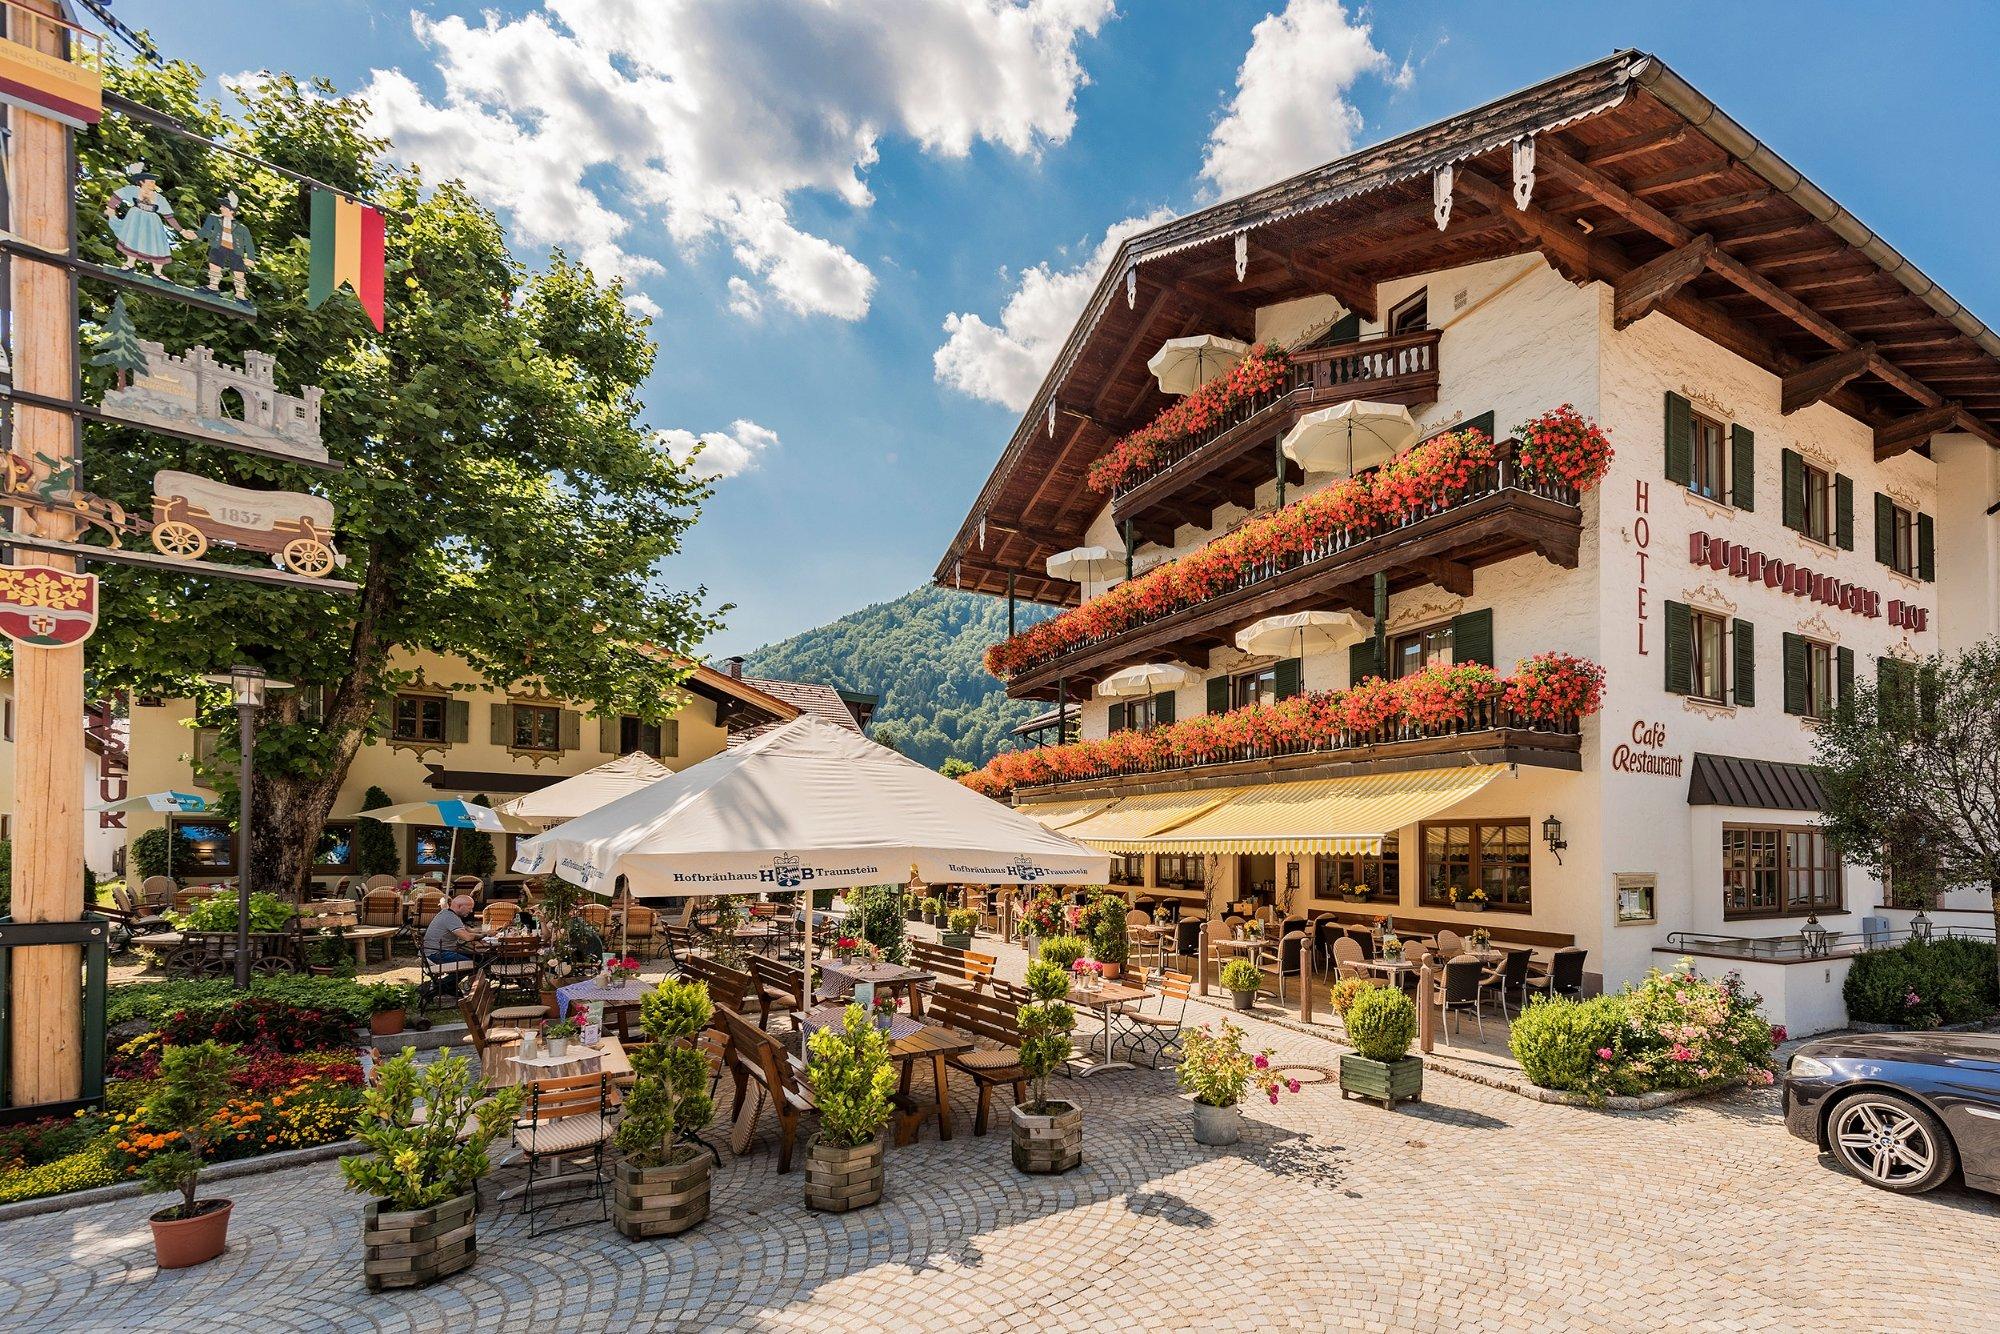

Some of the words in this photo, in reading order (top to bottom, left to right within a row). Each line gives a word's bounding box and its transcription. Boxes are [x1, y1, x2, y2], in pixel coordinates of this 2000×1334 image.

[0, 46, 77, 81] auschberg
[1635, 480, 1649, 656] HOTEL
[1690, 530, 1882, 618] RUHPOLDINGER
[1888, 599, 1930, 632] HOF
[1632, 720, 1665, 750] Café
[100, 688, 128, 828] ISEUR
[1612, 744, 1683, 777] Restaurant
[673, 872, 758, 882] Hofbräuhaus
[816, 865, 878, 876] Traunstein
[948, 864, 1006, 874] Hofbräuhaus
